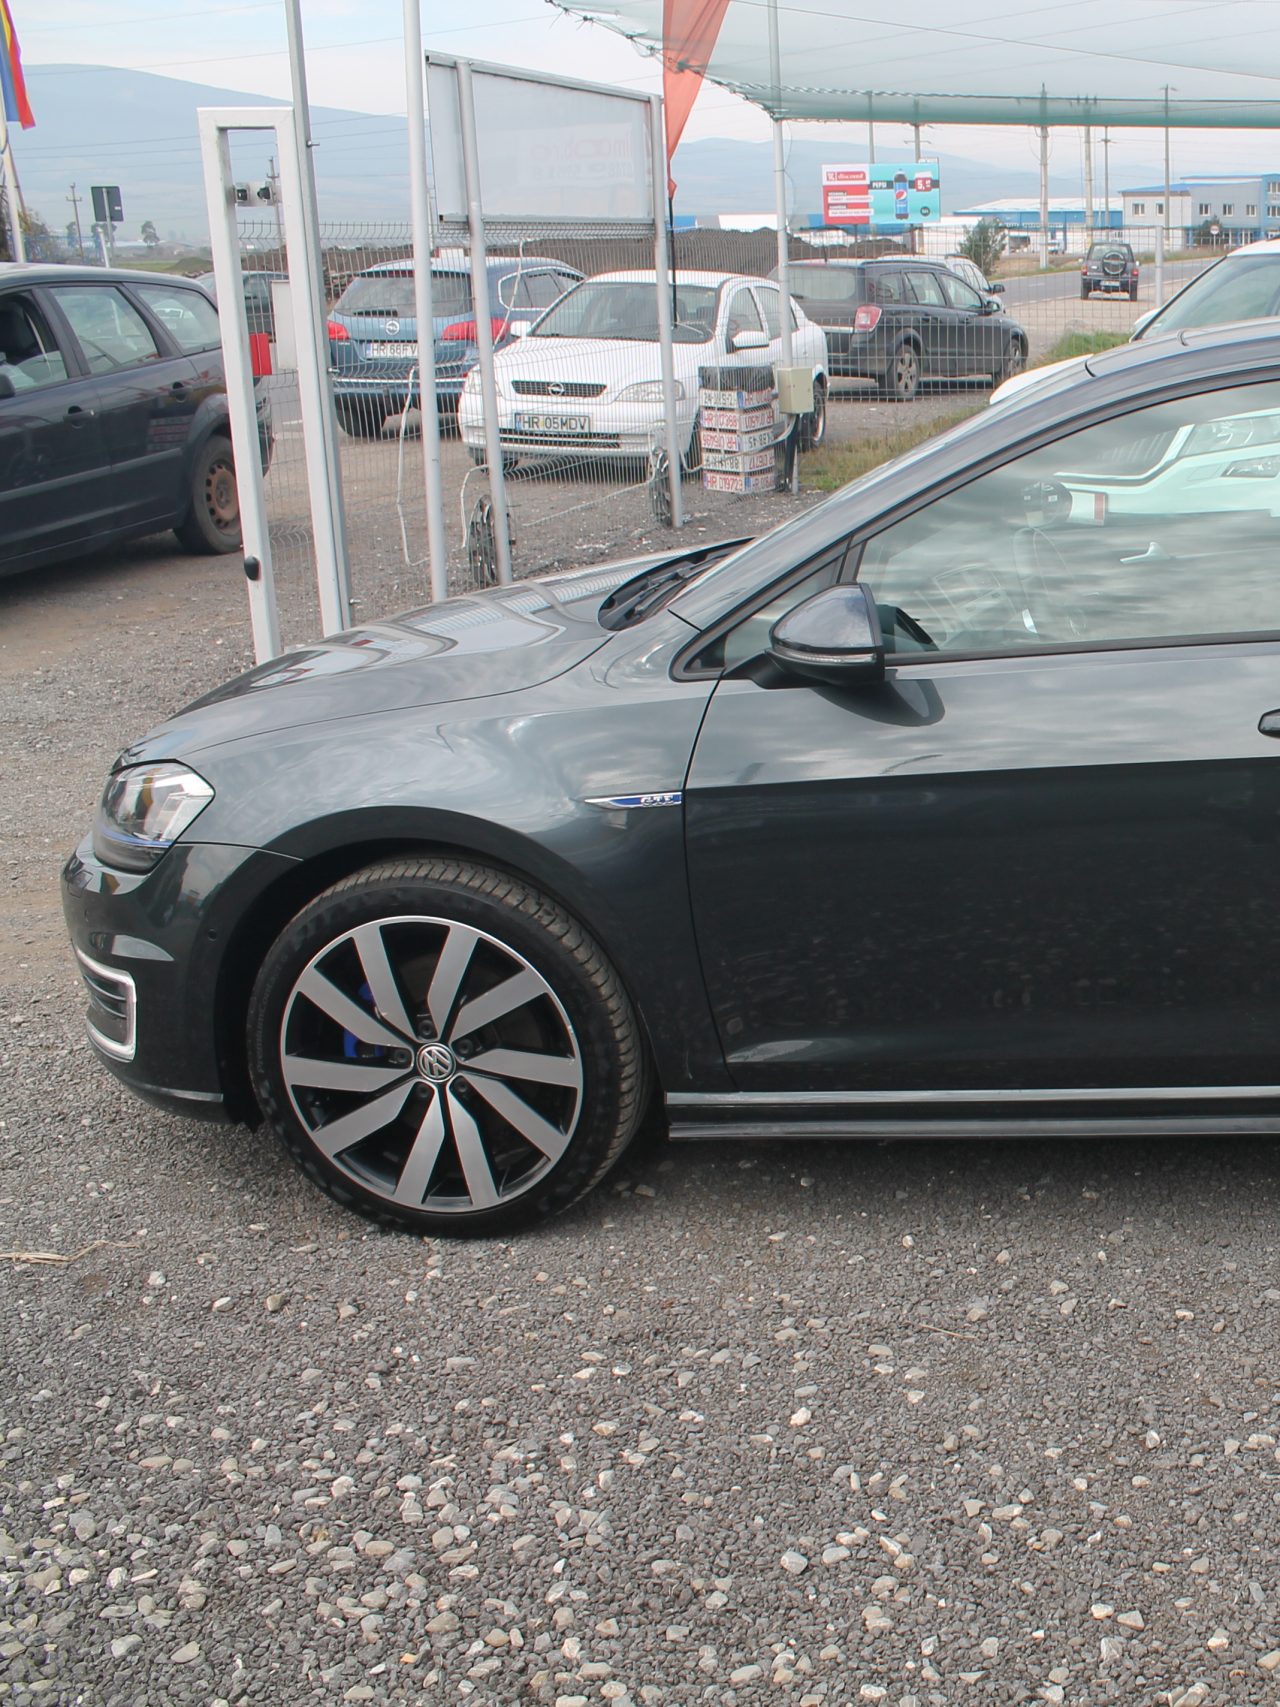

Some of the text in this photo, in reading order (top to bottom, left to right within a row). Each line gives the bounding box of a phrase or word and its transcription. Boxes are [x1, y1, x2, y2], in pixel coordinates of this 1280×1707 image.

[389, 343, 419, 356] 66FV
[522, 415, 587, 431] HR 05MDV
[640, 795, 674, 807] GTE
